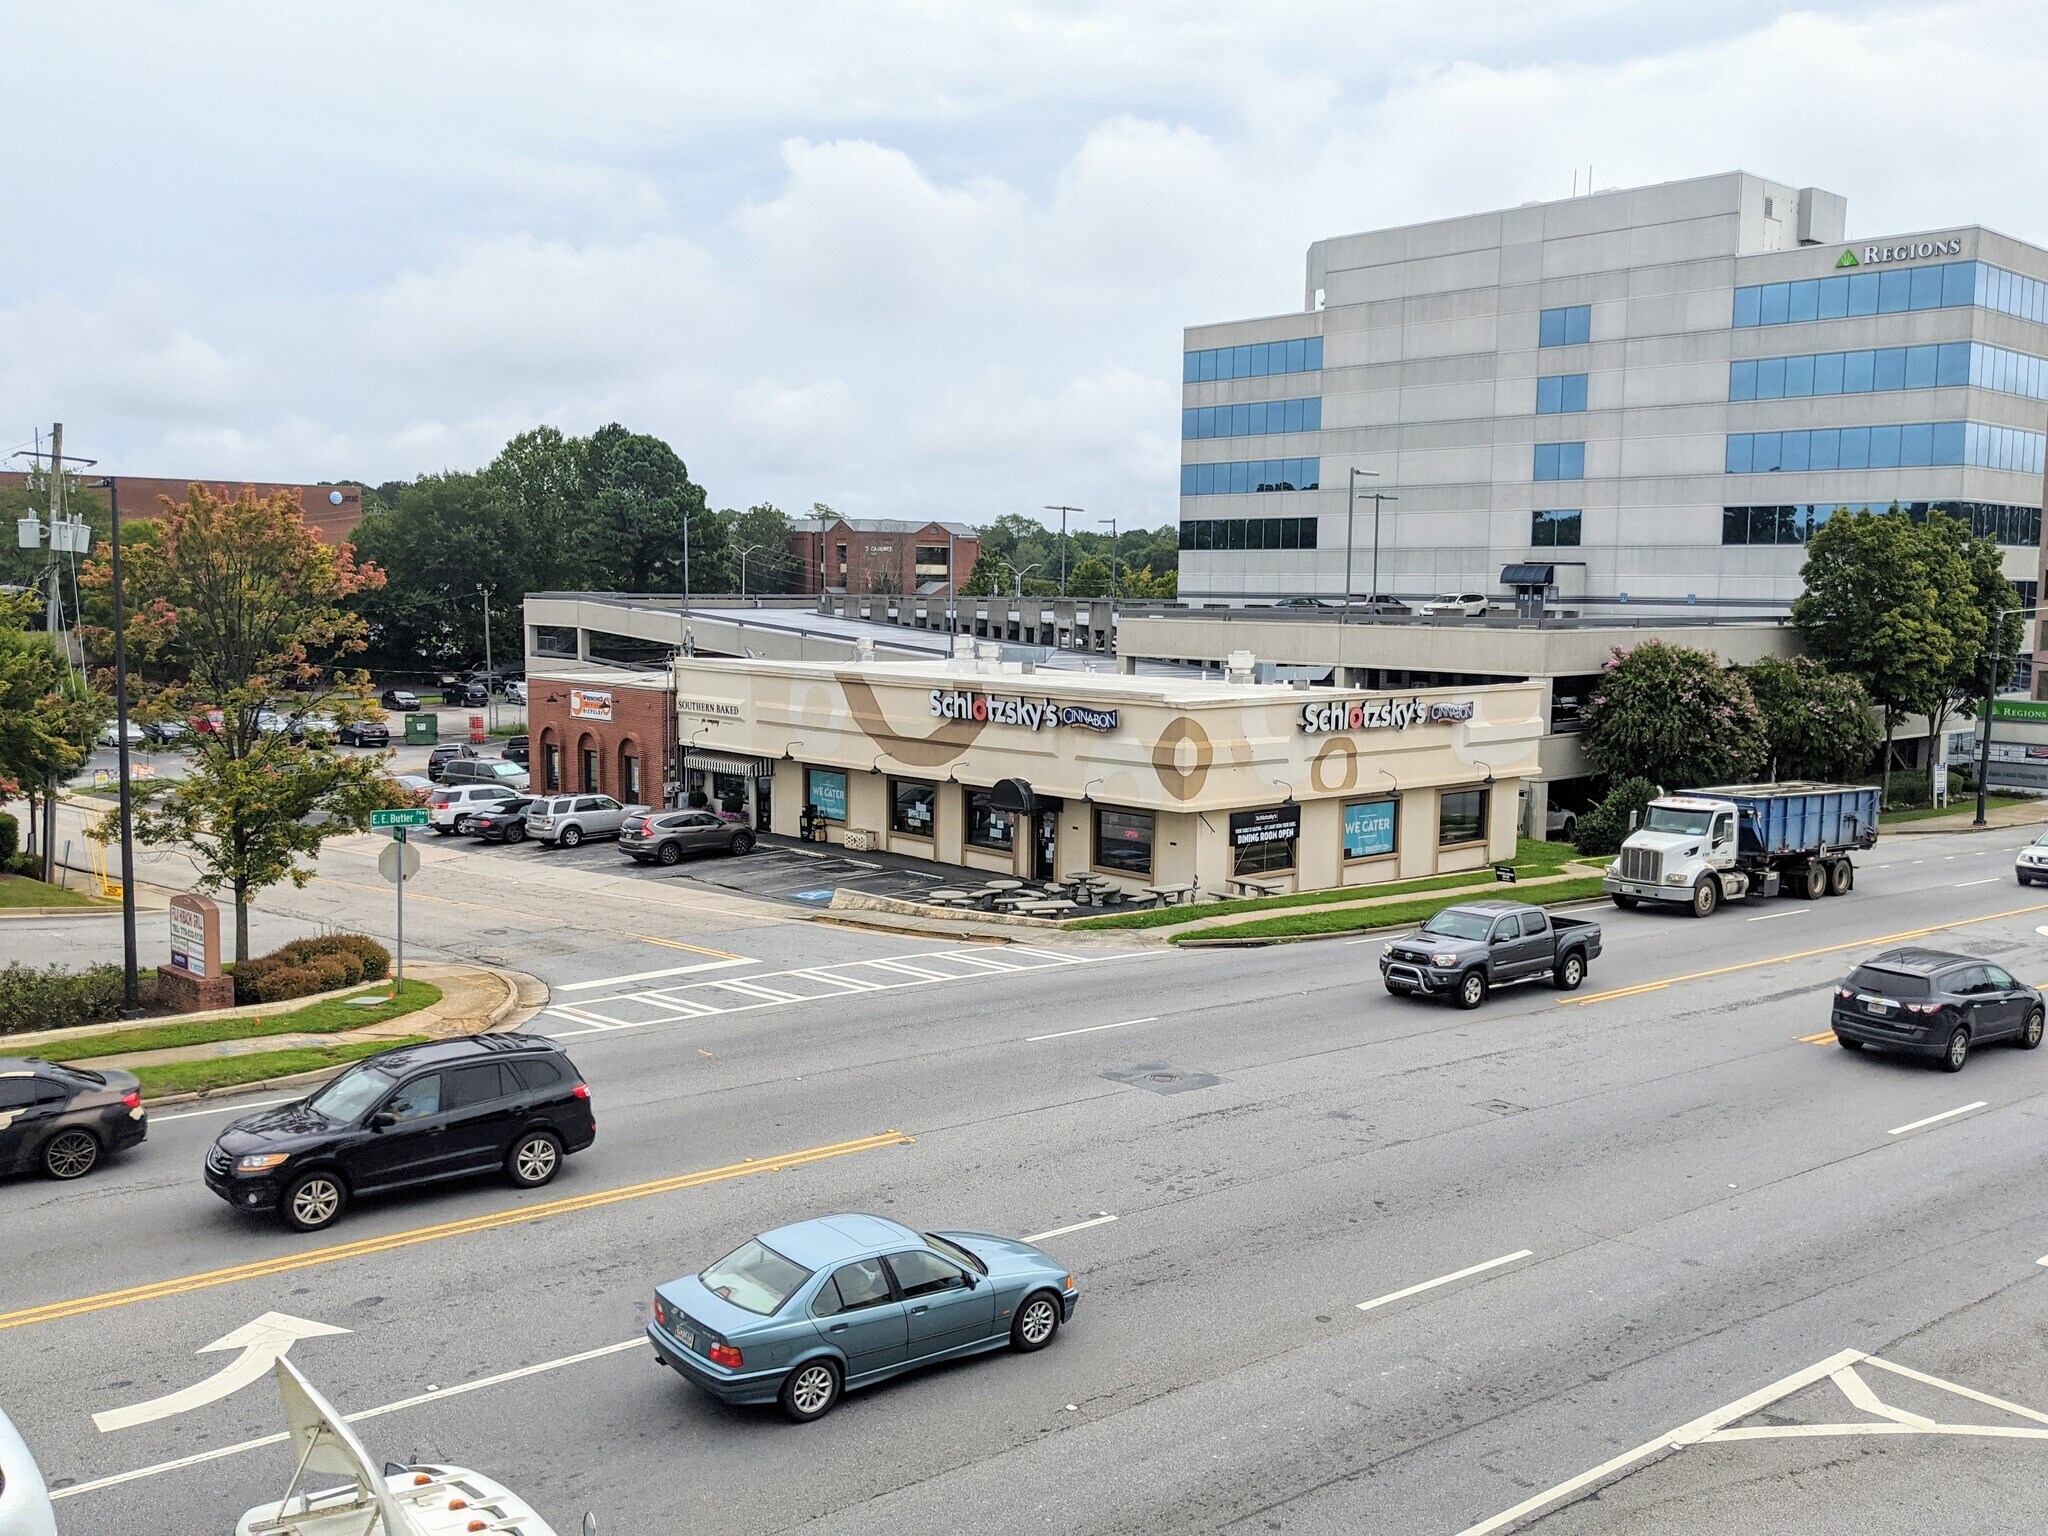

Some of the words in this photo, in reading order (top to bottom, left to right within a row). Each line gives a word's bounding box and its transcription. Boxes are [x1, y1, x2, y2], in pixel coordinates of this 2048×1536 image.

[1863, 239, 1960, 264] REGIONS
[678, 700, 715, 712] SOUTHERN
[716, 704, 739, 715] BAKED
[929, 689, 1060, 732] Schlotzsky's
[1063, 706, 1116, 729] CINNABON
[1303, 697, 1427, 733] Schlotzsky's
[1431, 702, 1473, 720] CINNABON
[2003, 707, 2047, 718] REGIONS
[812, 786, 824, 796] WE
[824, 789, 845, 799] CATER
[372, 814, 380, 824] E.
[381, 814, 389, 824] E.
[390, 813, 414, 823] Butler
[1124, 829, 1139, 839] OPEN
[1344, 821, 1361, 835] WE
[1361, 818, 1390, 832] CATER
[1237, 832, 1260, 844] DINING
[1260, 830, 1278, 841] ROOM
[1278, 828, 1294, 839] OPEN
